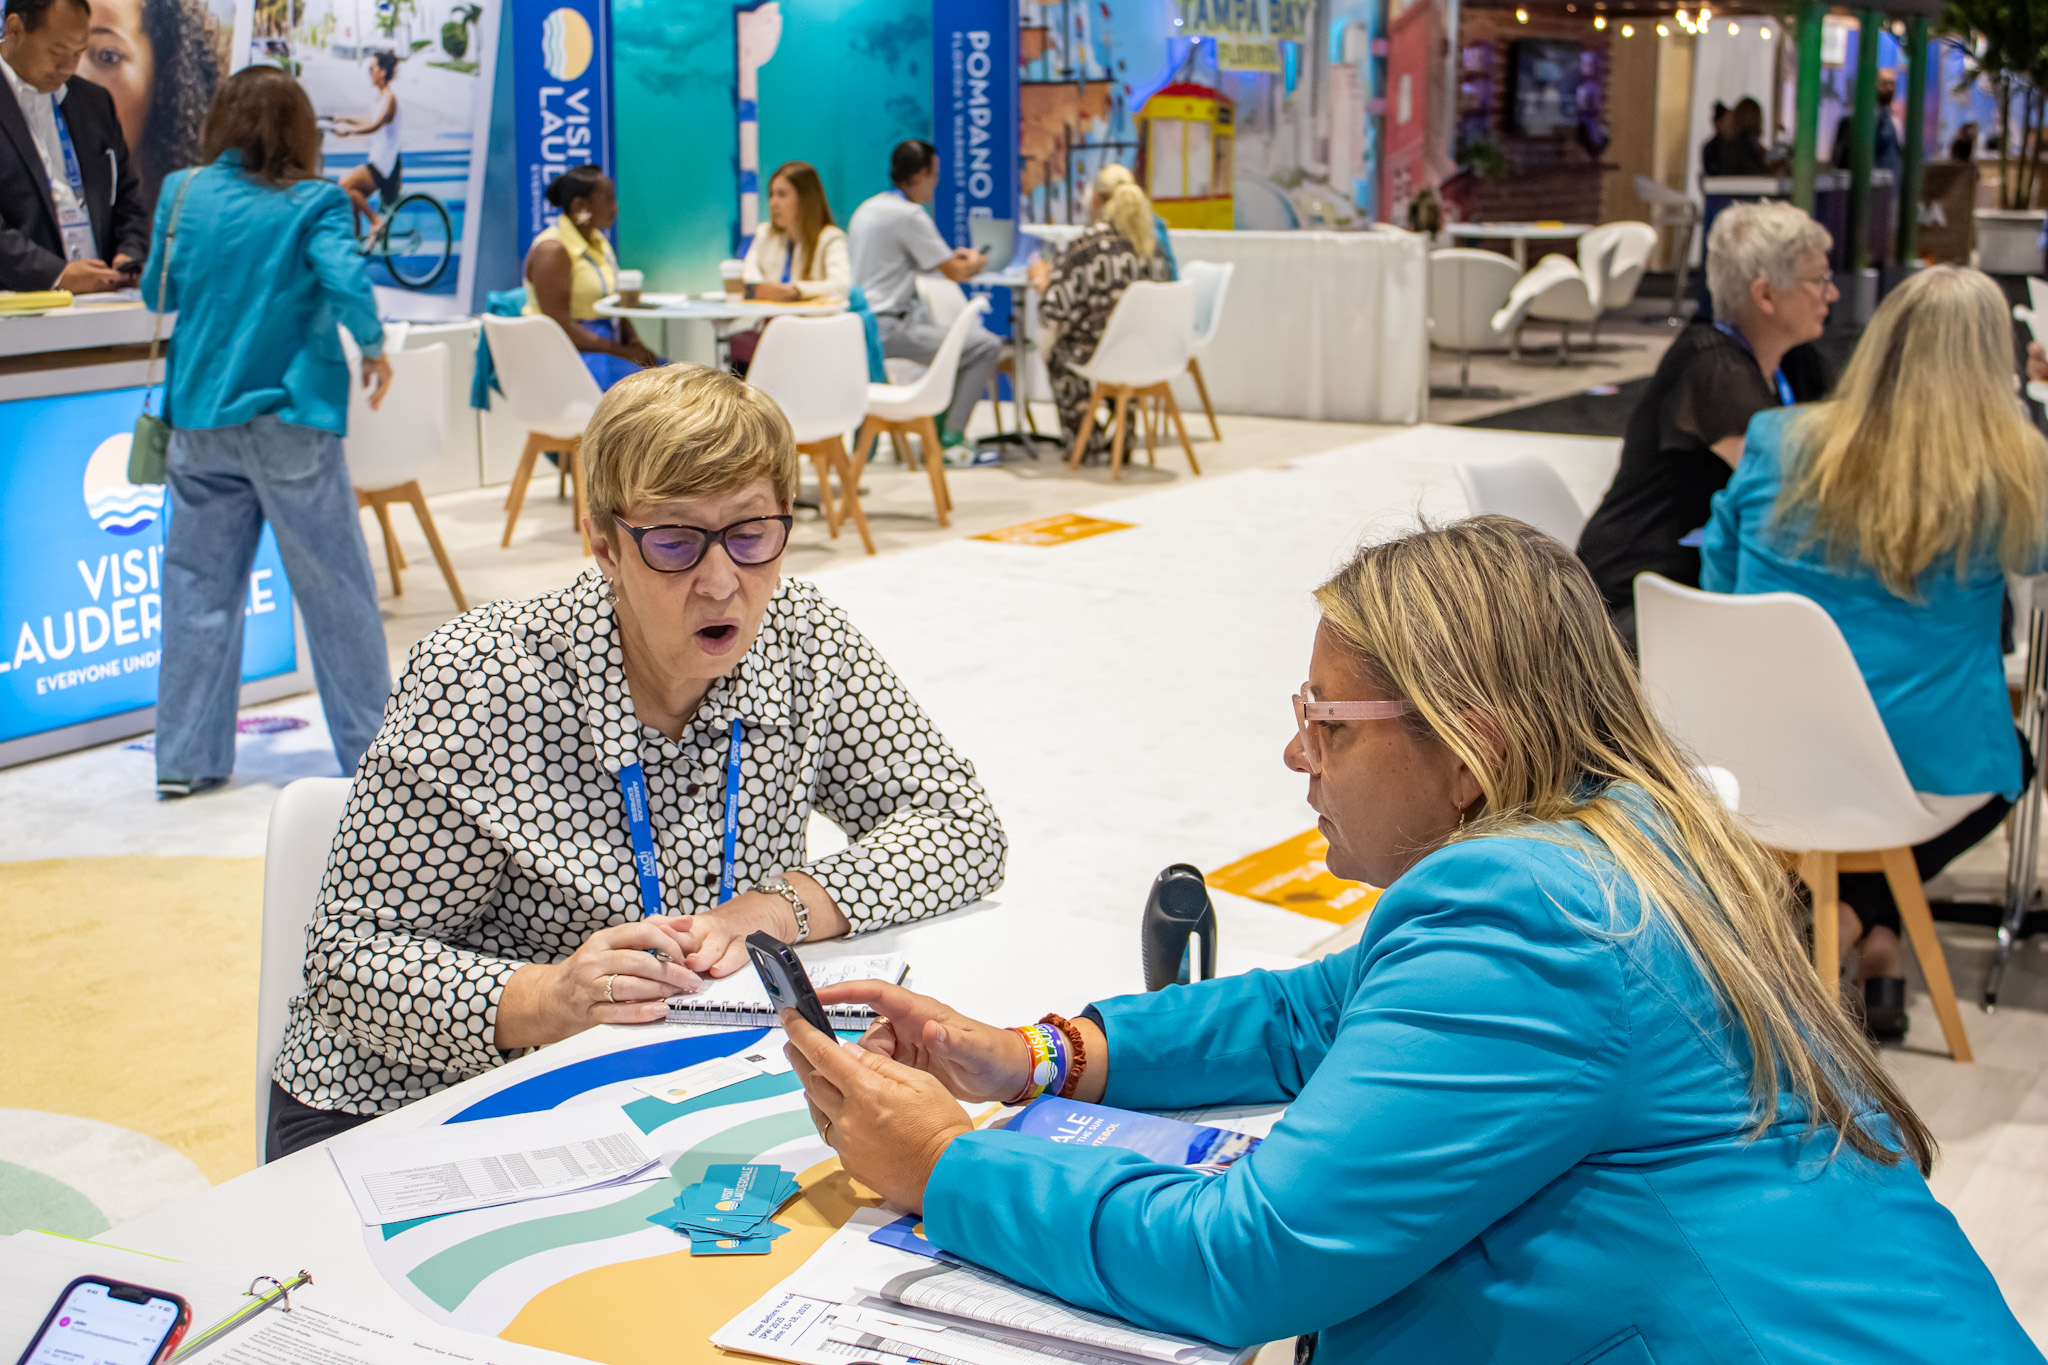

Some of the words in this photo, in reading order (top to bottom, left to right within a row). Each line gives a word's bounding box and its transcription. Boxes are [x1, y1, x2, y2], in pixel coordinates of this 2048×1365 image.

[966, 30, 993, 199] POMPANO
[36, 659, 121, 695] EVERYONE
[627, 787, 639, 823] EXPRESS
[632, 781, 644, 822] AMERICAN
[1025, 1030, 1046, 1059] VISIT
[1076, 1130, 1093, 1143] THE
[1088, 1117, 1105, 1131] SUN
[720, 1187, 735, 1201] VISIT
[731, 1166, 753, 1202] LAUDERDALE
[747, 1323, 764, 1337] Know
[761, 1308, 780, 1324] Before
[777, 1299, 789, 1309] You
[759, 1328, 773, 1340] IPW
[769, 1317, 785, 1329] 2025
[770, 1330, 786, 1342] June
[796, 1303, 812, 1315] 2025
